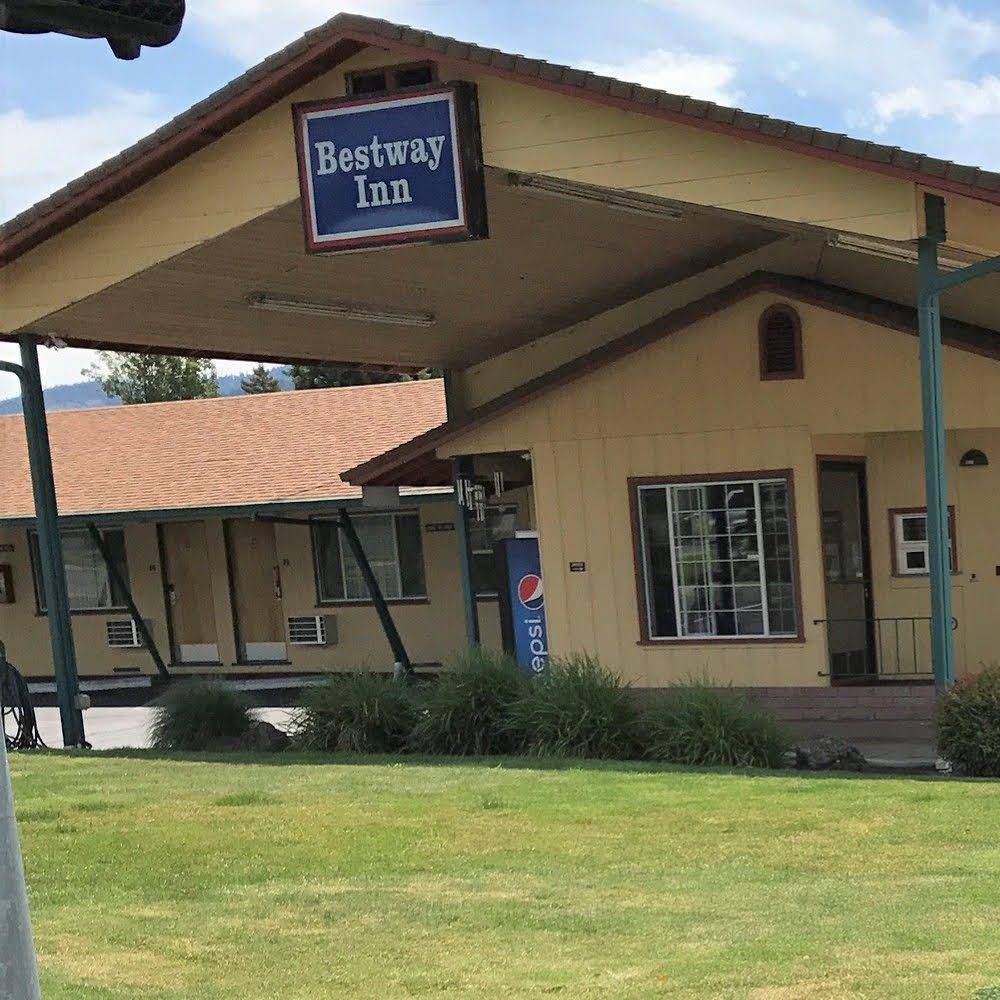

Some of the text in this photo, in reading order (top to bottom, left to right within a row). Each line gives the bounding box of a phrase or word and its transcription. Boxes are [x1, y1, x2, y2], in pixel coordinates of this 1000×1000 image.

[314, 135, 446, 176] Bestway
[353, 174, 413, 209] Inn
[524, 619, 548, 673] epsi
